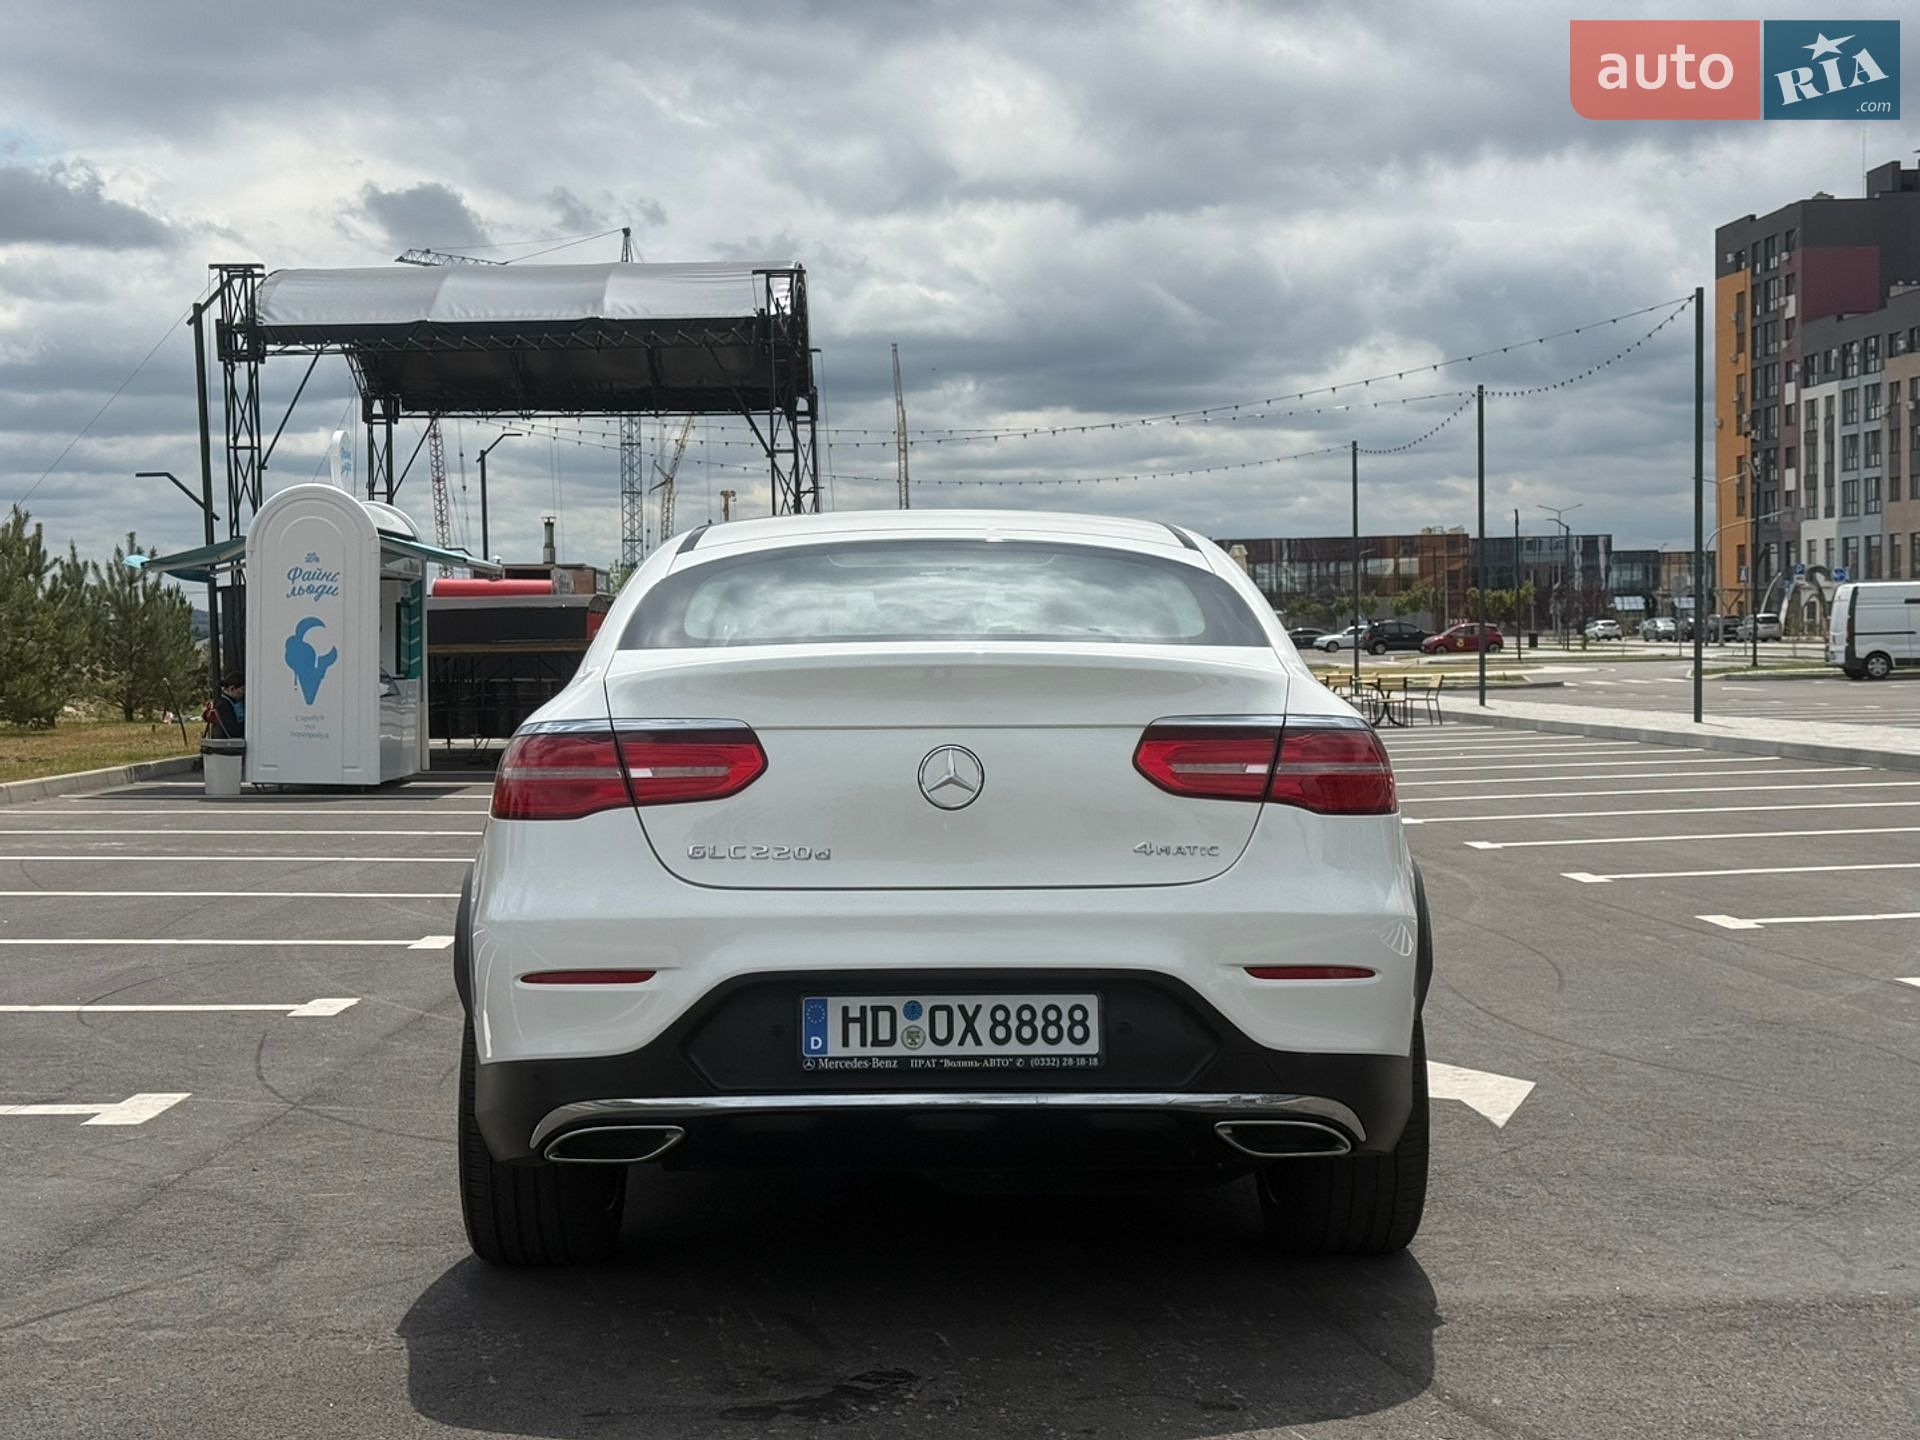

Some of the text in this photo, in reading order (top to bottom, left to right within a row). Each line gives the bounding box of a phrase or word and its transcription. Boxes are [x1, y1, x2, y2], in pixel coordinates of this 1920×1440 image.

[286, 584, 339, 602] льоди
[1133, 840, 1220, 857] 4MATIC
[810, 1003, 1091, 1050] D HD OX8888
[818, 1058, 898, 1070] Mercedes-Benz
